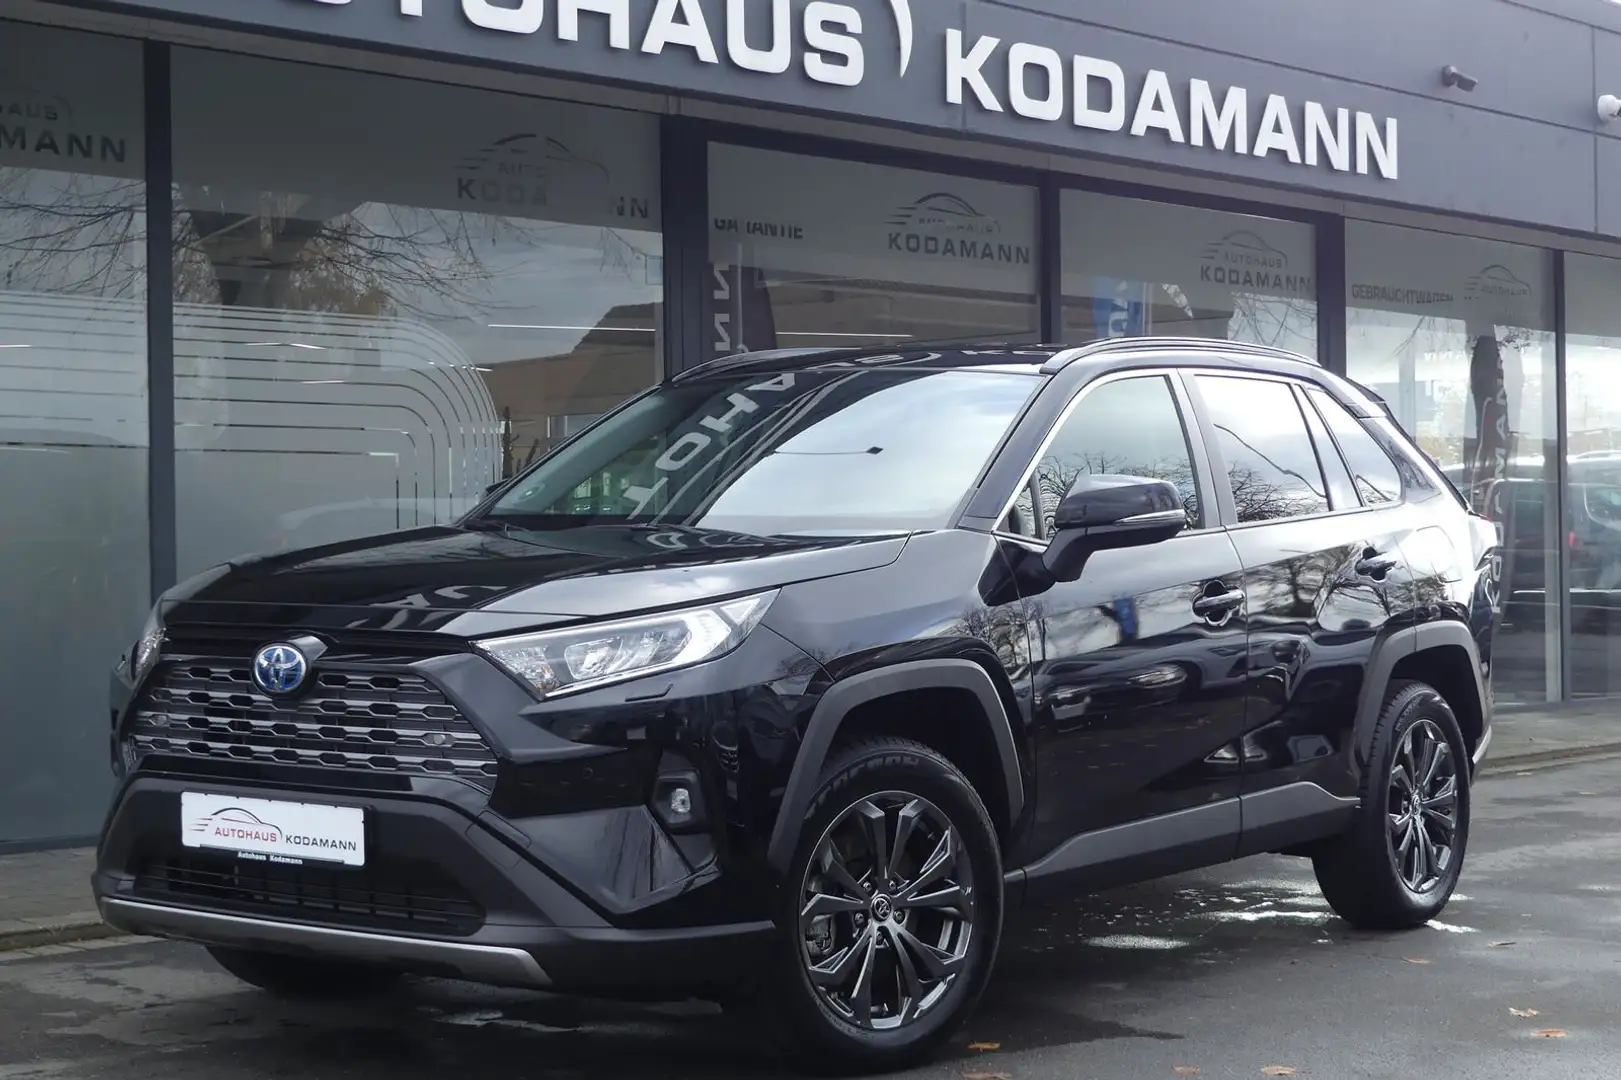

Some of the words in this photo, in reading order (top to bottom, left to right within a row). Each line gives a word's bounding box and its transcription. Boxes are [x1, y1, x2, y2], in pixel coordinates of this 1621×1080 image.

[945, 28, 1399, 180] KODAMANN
[888, 231, 1031, 264] KODAMANN
[1200, 264, 1312, 294] KODAMANN
[214, 826, 277, 842] AUTOHAUS
[285, 835, 357, 851] KODAMANN
[237, 851, 267, 861] Autohaus
[269, 855, 303, 865] Kodamann
